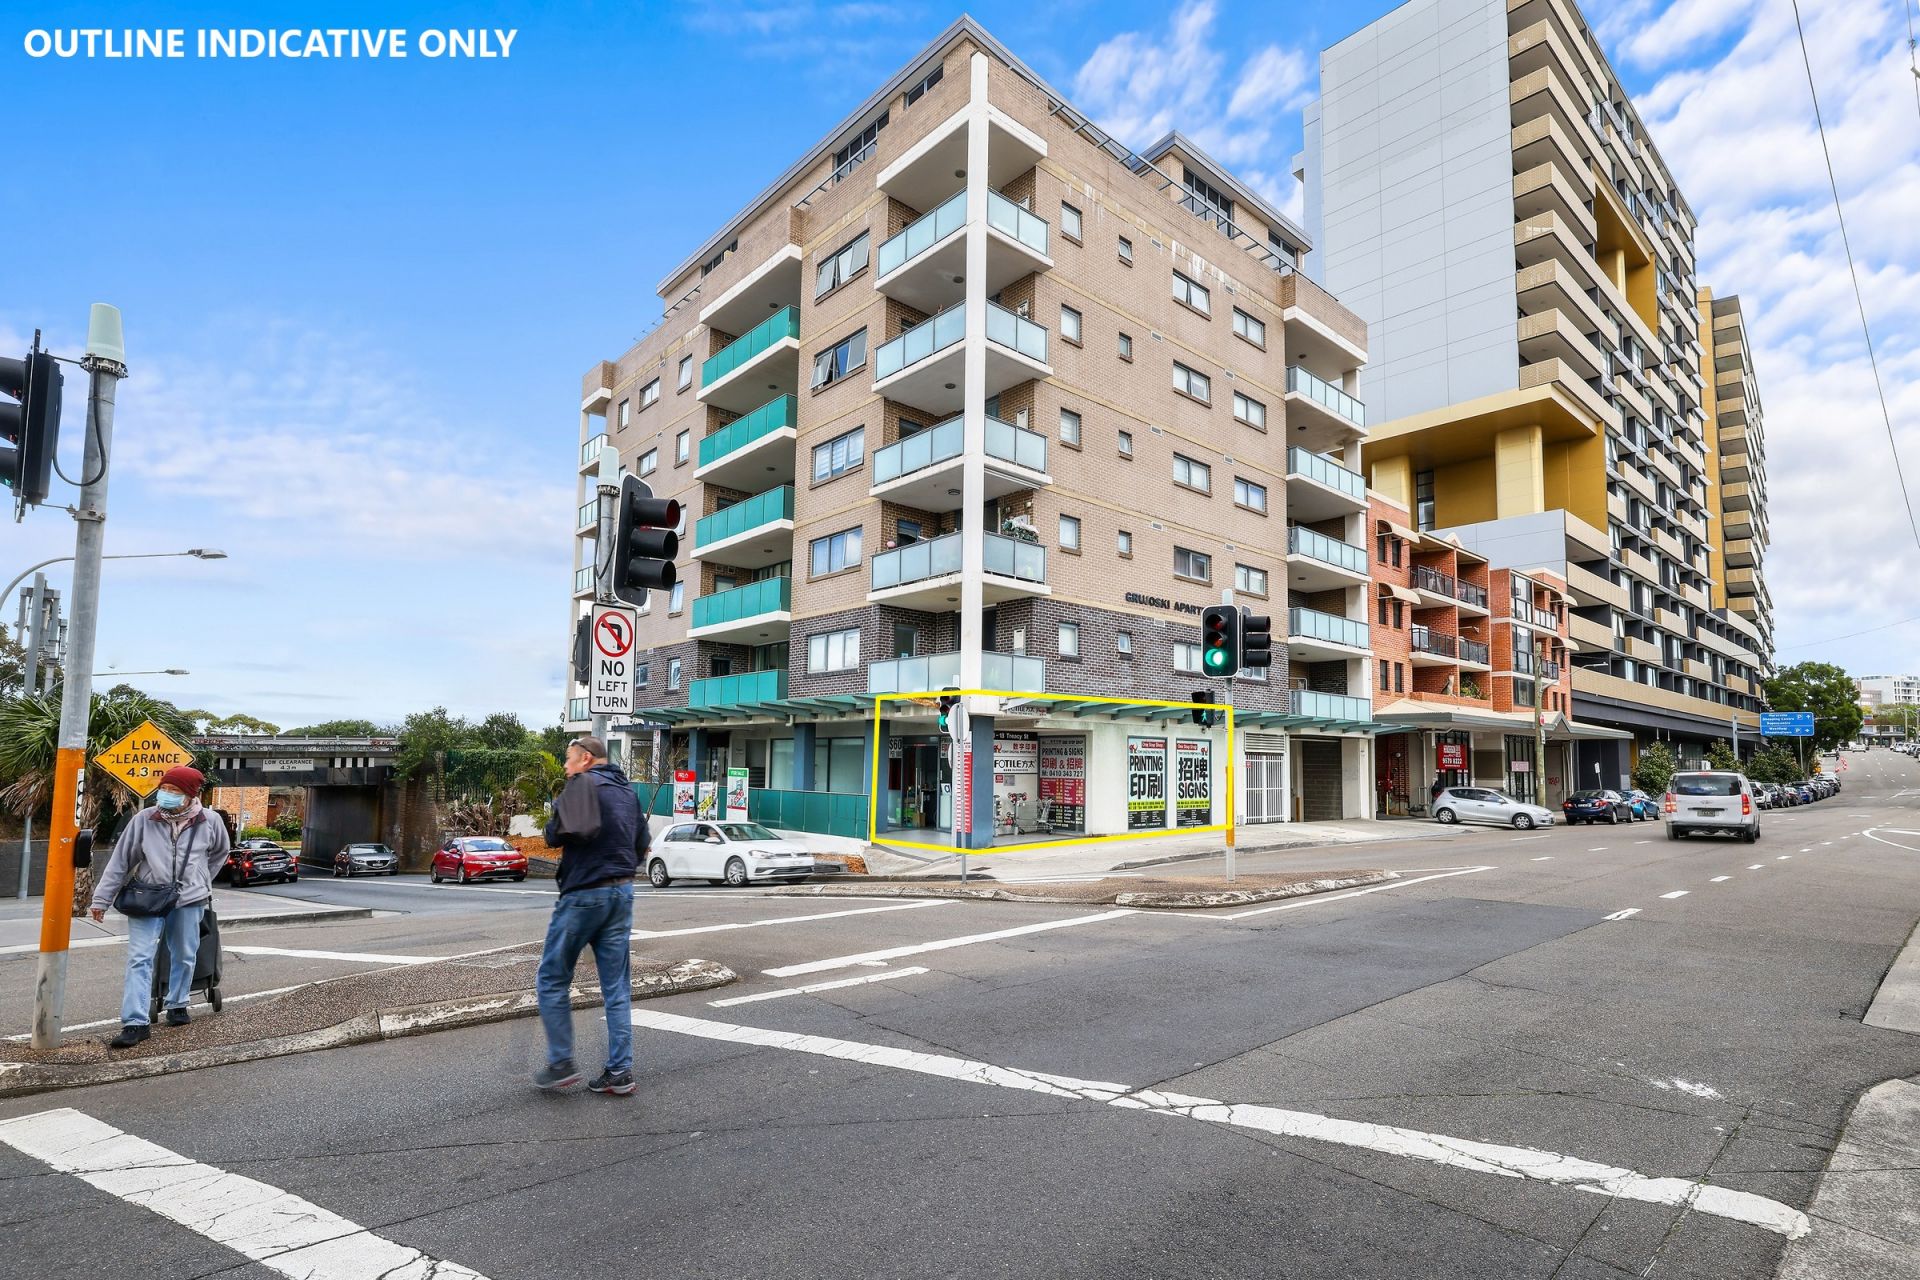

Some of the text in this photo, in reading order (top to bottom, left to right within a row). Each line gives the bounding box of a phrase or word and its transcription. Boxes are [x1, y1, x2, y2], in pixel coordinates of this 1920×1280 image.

[1174, 602, 1203, 615] APART
[601, 659, 625, 676] NO
[598, 681, 628, 692] LEFT
[596, 696, 628, 707] TURN
[132, 740, 161, 750] LOW
[1042, 748, 1083, 756] PRINTING & SIGNS
[108, 753, 180, 764] CLEARANCE
[1129, 755, 1163, 771] PRINTING
[1059, 760, 1065, 769] &
[1178, 757, 1208, 781] 招牌
[126, 767, 149, 777] 4.3
[1130, 773, 1163, 799] 印刷
[1178, 782, 1208, 799] SIGNS
